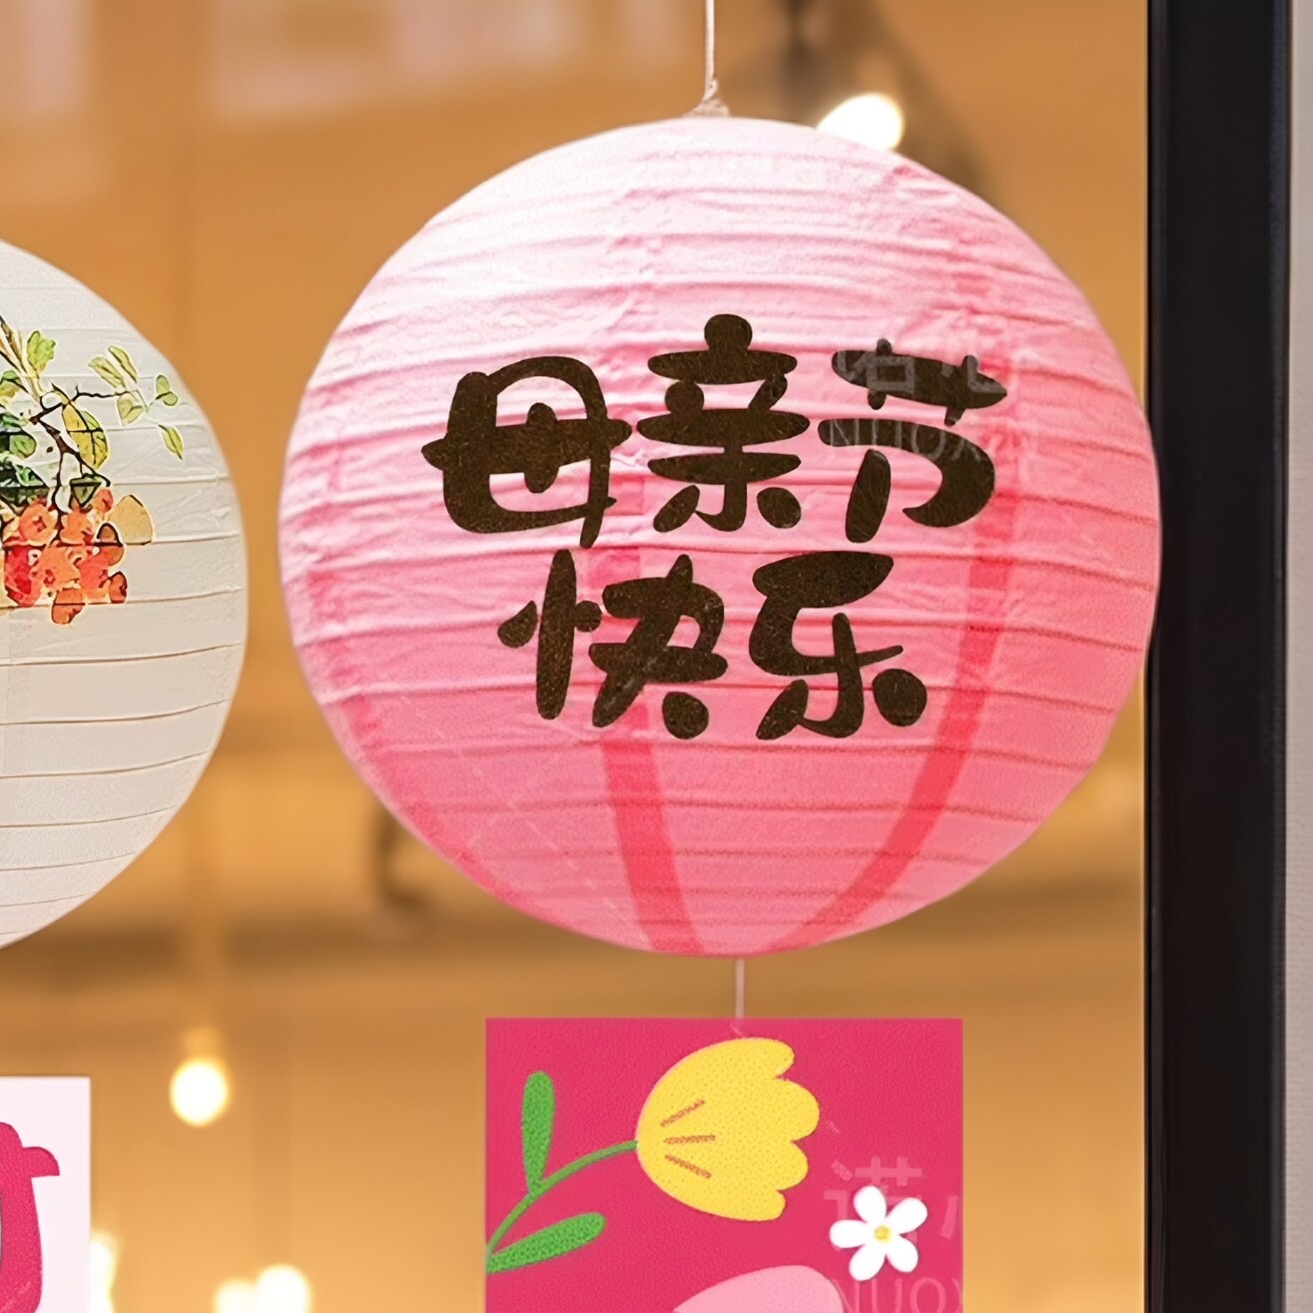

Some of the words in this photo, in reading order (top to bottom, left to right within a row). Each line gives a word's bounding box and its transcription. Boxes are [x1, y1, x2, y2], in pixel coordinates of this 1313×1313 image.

[421, 314, 1008, 547] 母亲节
[497, 549, 928, 740] 快乐
